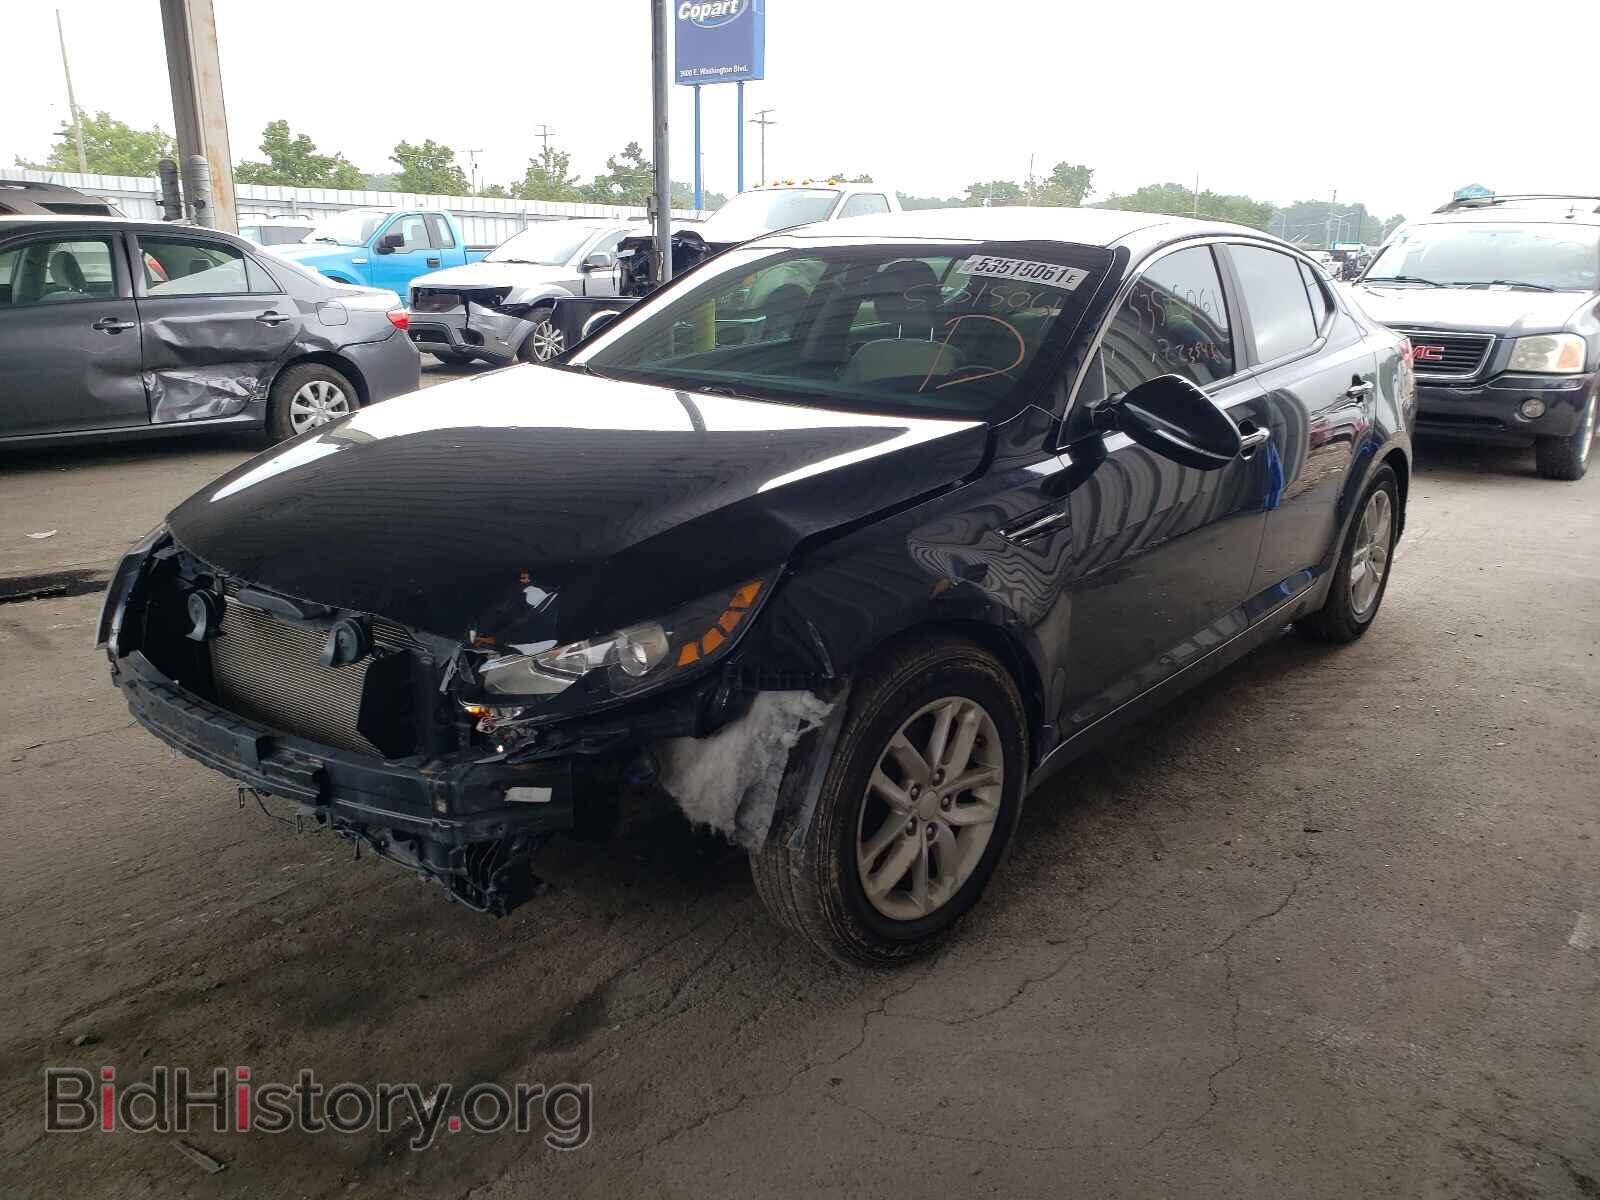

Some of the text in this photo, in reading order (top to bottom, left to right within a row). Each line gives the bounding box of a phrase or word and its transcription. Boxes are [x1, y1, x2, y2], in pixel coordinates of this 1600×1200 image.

[678, 0, 739, 22] Copart
[700, 66, 733, 75] Washington
[732, 64, 749, 73] Blvd.
[974, 257, 1067, 283] 53515061
